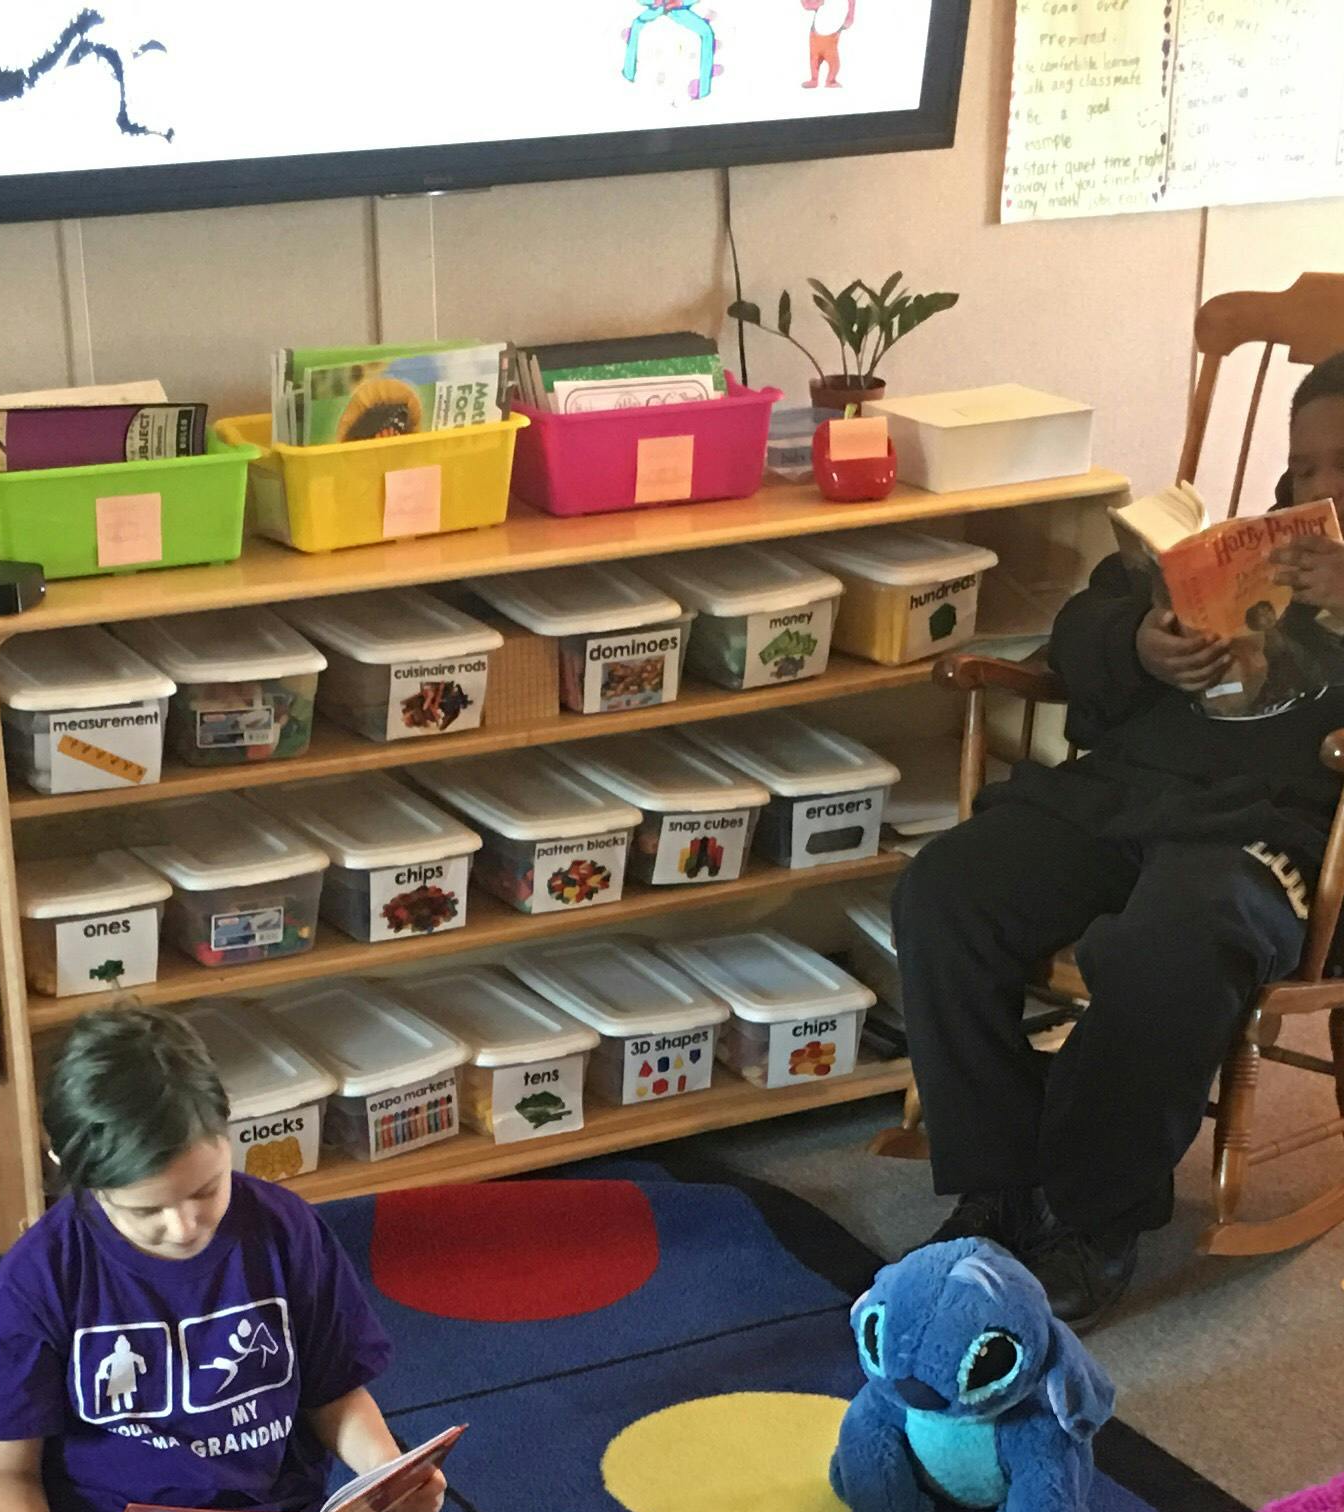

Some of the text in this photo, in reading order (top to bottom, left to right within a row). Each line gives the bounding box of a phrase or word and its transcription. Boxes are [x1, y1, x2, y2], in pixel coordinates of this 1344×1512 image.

[1211, 514, 1328, 568] Harry Potter
[909, 574, 978, 611] hundreds
[769, 610, 814, 631] money
[588, 634, 679, 662] dominoes
[393, 658, 488, 680] cuisinaire rods
[52, 709, 160, 733] measurement
[805, 797, 873, 820] erasers
[667, 815, 744, 836] snap cubes
[536, 834, 626, 859] pattern blocks
[394, 863, 444, 887] chips
[82, 917, 131, 940] ones
[792, 1016, 838, 1040] chips
[629, 1029, 710, 1057] 3D shapes
[522, 1066, 560, 1087] tens
[369, 1077, 456, 1115] expo markers
[237, 1115, 305, 1145] clocks
[230, 1400, 258, 1427] MY
[190, 1415, 294, 1459] GRANDMA
